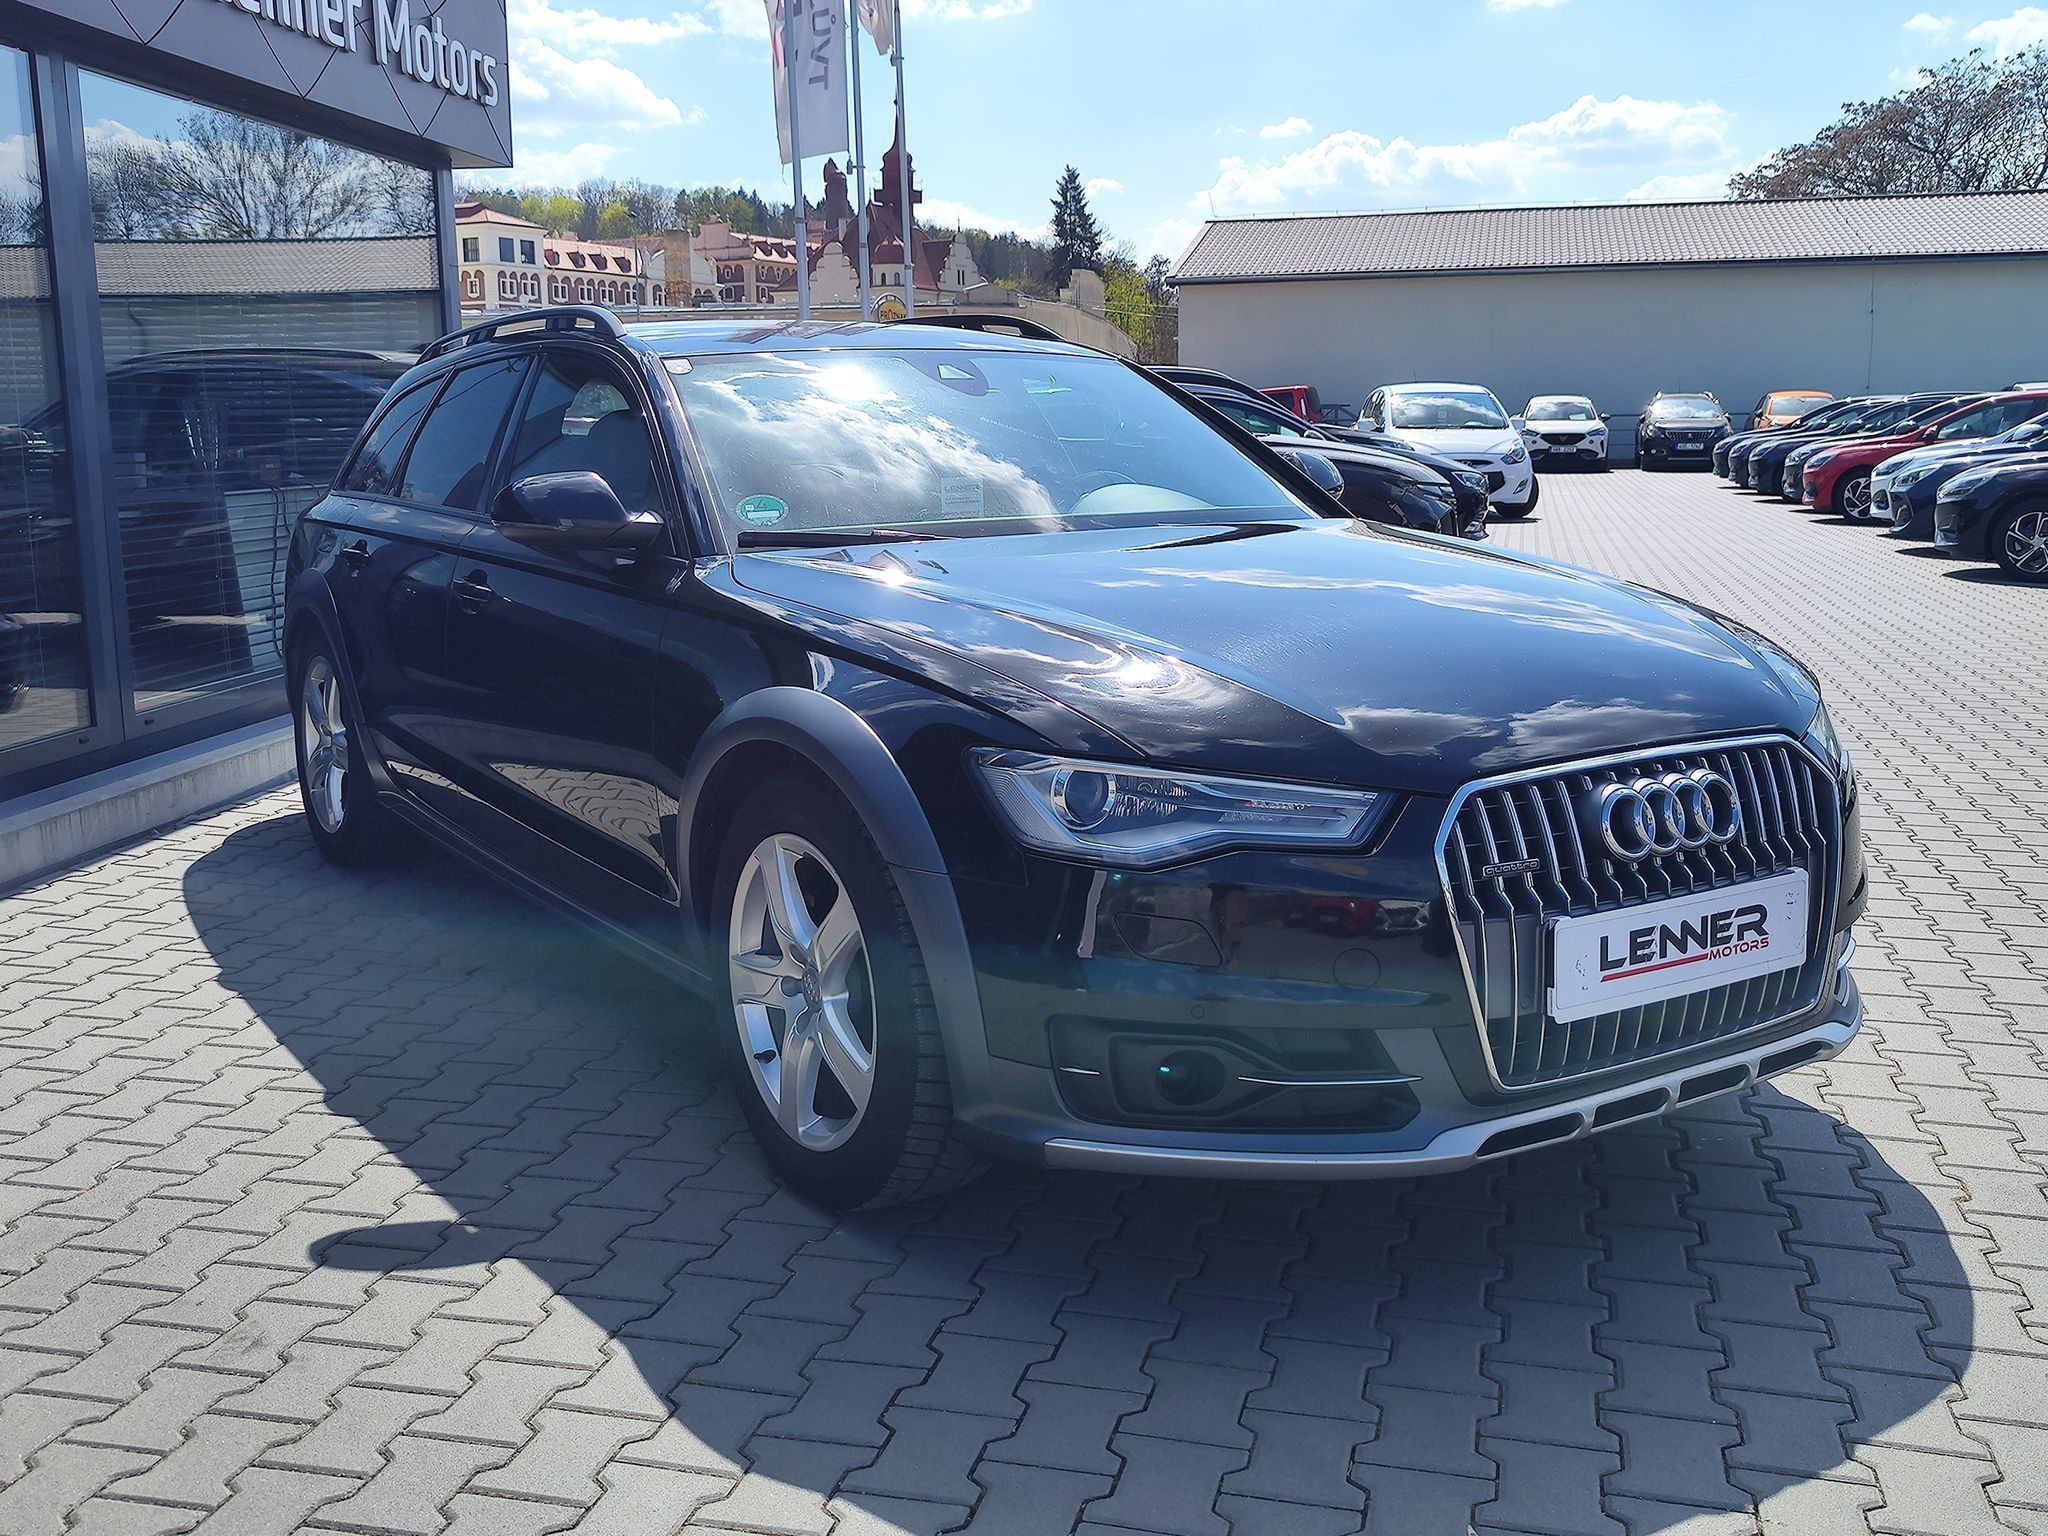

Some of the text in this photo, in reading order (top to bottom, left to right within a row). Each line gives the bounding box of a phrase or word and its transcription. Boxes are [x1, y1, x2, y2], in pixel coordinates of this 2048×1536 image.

[221, 0, 499, 107] ner Motors
[1486, 861, 1538, 875] quattro
[1599, 903, 1769, 972] LENNER
[1708, 936, 1770, 961] MOTORS
